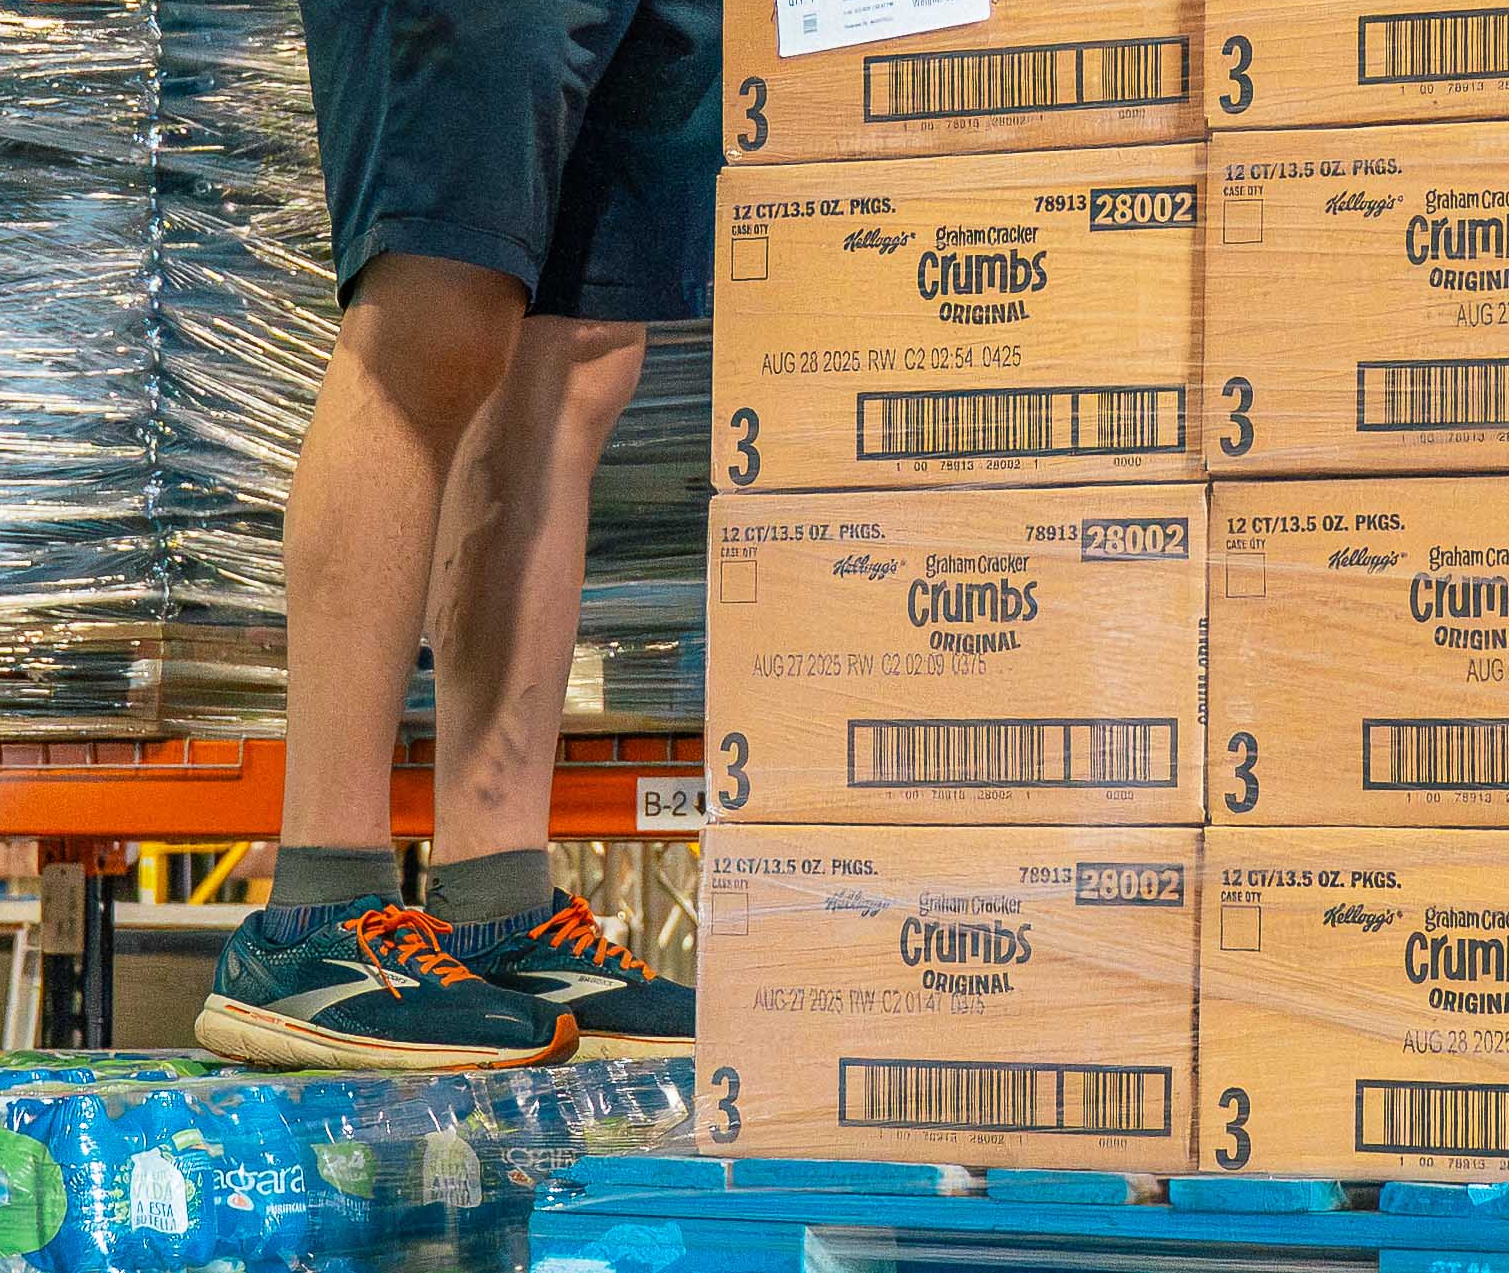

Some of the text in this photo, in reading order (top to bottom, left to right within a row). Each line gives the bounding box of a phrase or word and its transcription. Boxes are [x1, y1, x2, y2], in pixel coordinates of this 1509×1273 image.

[1218, 34, 1254, 115] 3
[737, 75, 769, 152] 3
[1034, 191, 1194, 225] 78913 28002
[1325, 192, 1396, 218] Kellogg's
[843, 228, 911, 255] Kellogg's
[989, 224, 1039, 245] Cracker
[917, 248, 1047, 300] Crumbs
[938, 300, 1030, 325] ORIGINAL
[761, 344, 1022, 376] AUG 28 2025 RW C2 02:54 0425
[1219, 375, 1255, 458] 3
[728, 407, 761, 487] 3
[1025, 524, 1186, 555] 78913 28002
[1226, 513, 1406, 535] 12 CT/13.5 OZ. PKGS.
[1225, 538, 1267, 550] CASE QTY
[977, 554, 1030, 574] Cracker
[1328, 547, 1400, 573] Kellogg's
[907, 577, 1038, 627] Crumbs
[929, 629, 1021, 654] ORIGINAL
[718, 731, 750, 811] 3
[1223, 731, 1260, 814] 3
[644, 792, 688, 817] B-2
[1018, 867, 1181, 902] 78913 28002
[1221, 869, 1402, 889] 12 CT/13.5 OZ. PKGS.
[1323, 904, 1395, 932] Kellogg's
[900, 916, 1032, 966] Crumbs
[922, 970, 1014, 995] ORIGINAL
[1402, 1029, 1445, 1055] AUG
[1447, 1030, 1469, 1055] 28
[710, 1066, 741, 1144] 3
[1214, 1087, 1252, 1171] 3
